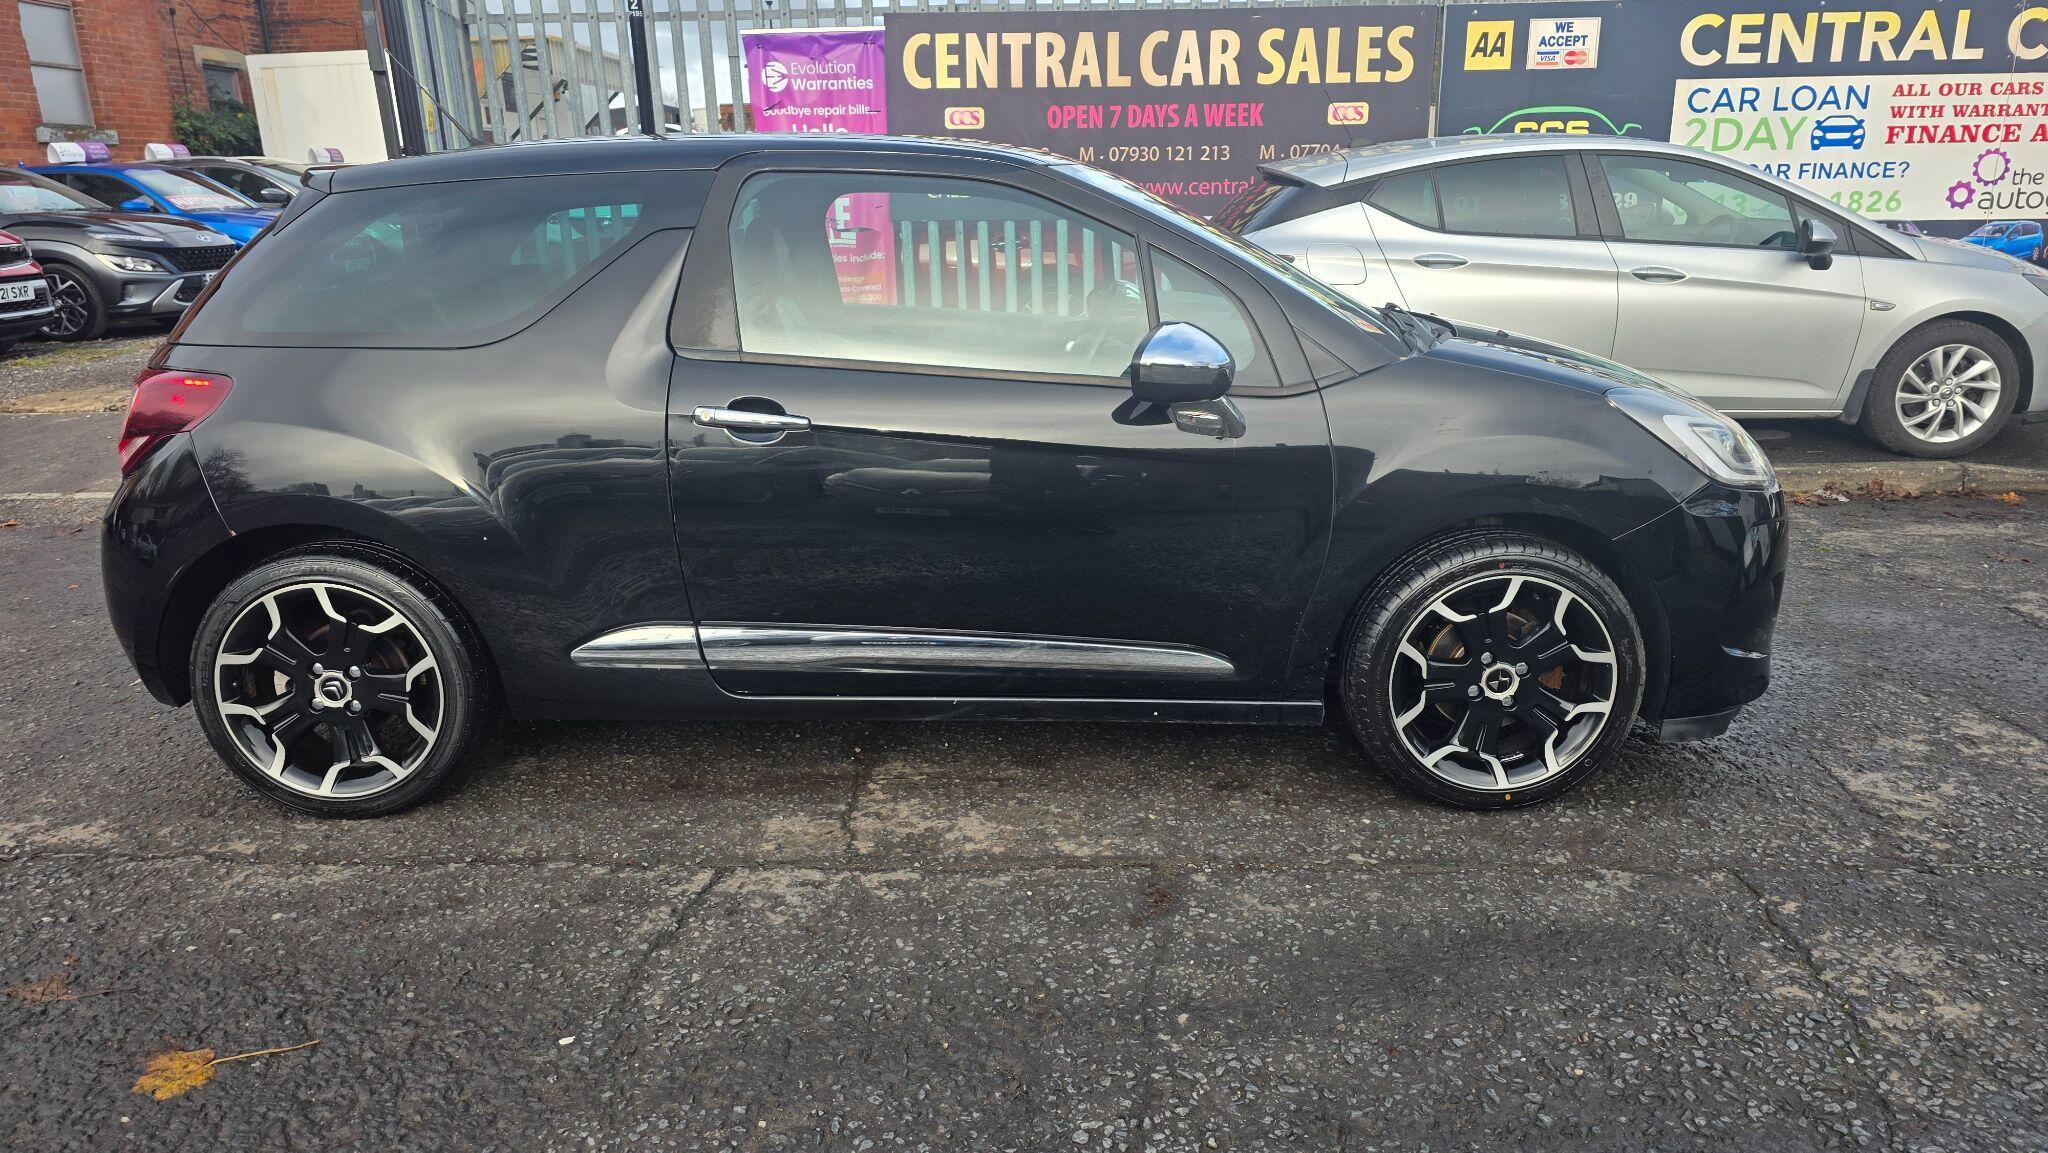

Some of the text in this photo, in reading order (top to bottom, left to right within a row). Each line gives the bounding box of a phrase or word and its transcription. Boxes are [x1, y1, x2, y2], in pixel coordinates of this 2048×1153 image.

[1555, 22, 1574, 33] WE
[1470, 32, 1506, 58] AA
[1538, 35, 1588, 47] ACCEPT
[1680, 9, 1985, 66] CENTRAL
[903, 26, 1415, 90] CENTRAL CAR SALES
[791, 62, 856, 75] Evolution
[791, 76, 874, 91] Warranties
[1892, 81, 2044, 97] ALL OUR CARS
[1687, 85, 1871, 113] CAR LOAN
[812, 105, 846, 118] repair
[1047, 103, 1264, 129] OPEN 7 DAYS A WEEK
[1890, 104, 1945, 118] WITH
[1684, 116, 1809, 152] 2DAY
[1885, 123, 2023, 144] FINANCE
[1079, 145, 1230, 162] M 07930 121 213
[1259, 144, 1275, 160] M
[1750, 161, 1910, 180] AR FINANCE?
[2012, 168, 2045, 185] the
[1829, 189, 1902, 213] 1826
[1977, 187, 2048, 210] auto
[11, 286, 29, 299] SXR
